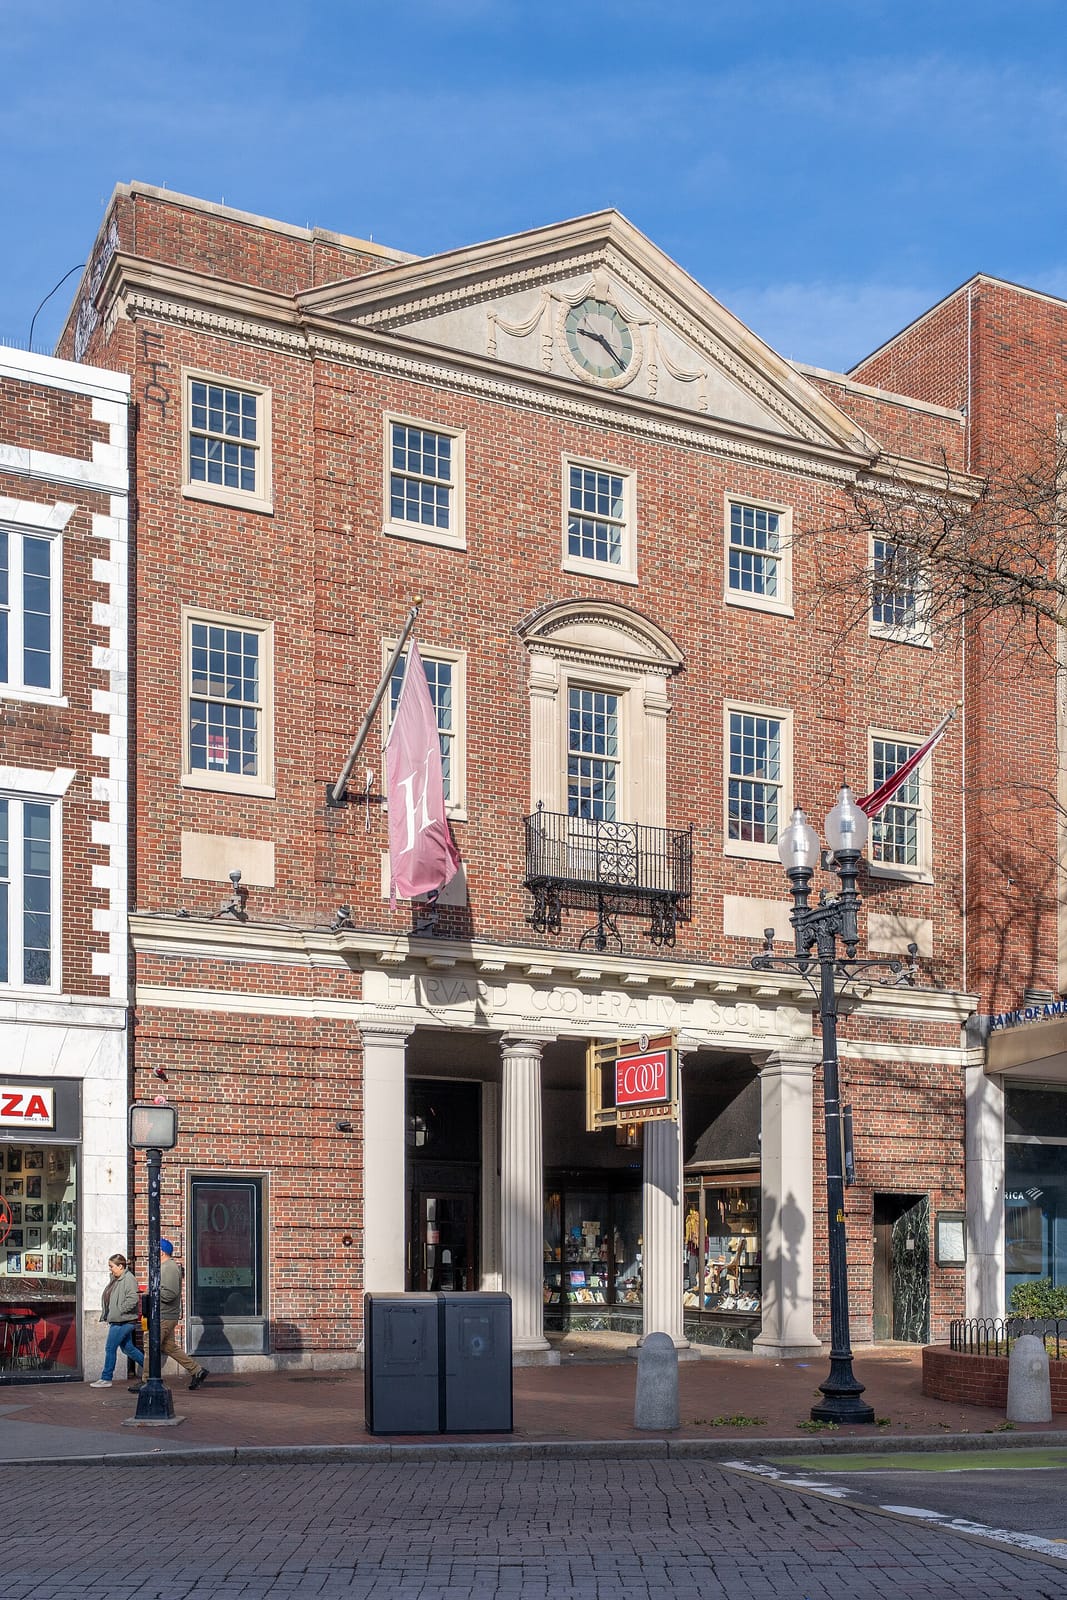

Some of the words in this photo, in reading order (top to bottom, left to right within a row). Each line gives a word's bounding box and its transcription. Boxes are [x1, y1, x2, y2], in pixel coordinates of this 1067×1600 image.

[387, 978, 508, 1008] HARVARD
[530, 989, 692, 1023] COOPERATIVE
[710, 1003, 799, 1033] SOCIETY
[990, 1009, 1021, 1026] BANK
[1025, 1006, 1040, 1019] OF
[624, 1062, 664, 1093] COOP
[621, 1106, 669, 1119] HARVARD
